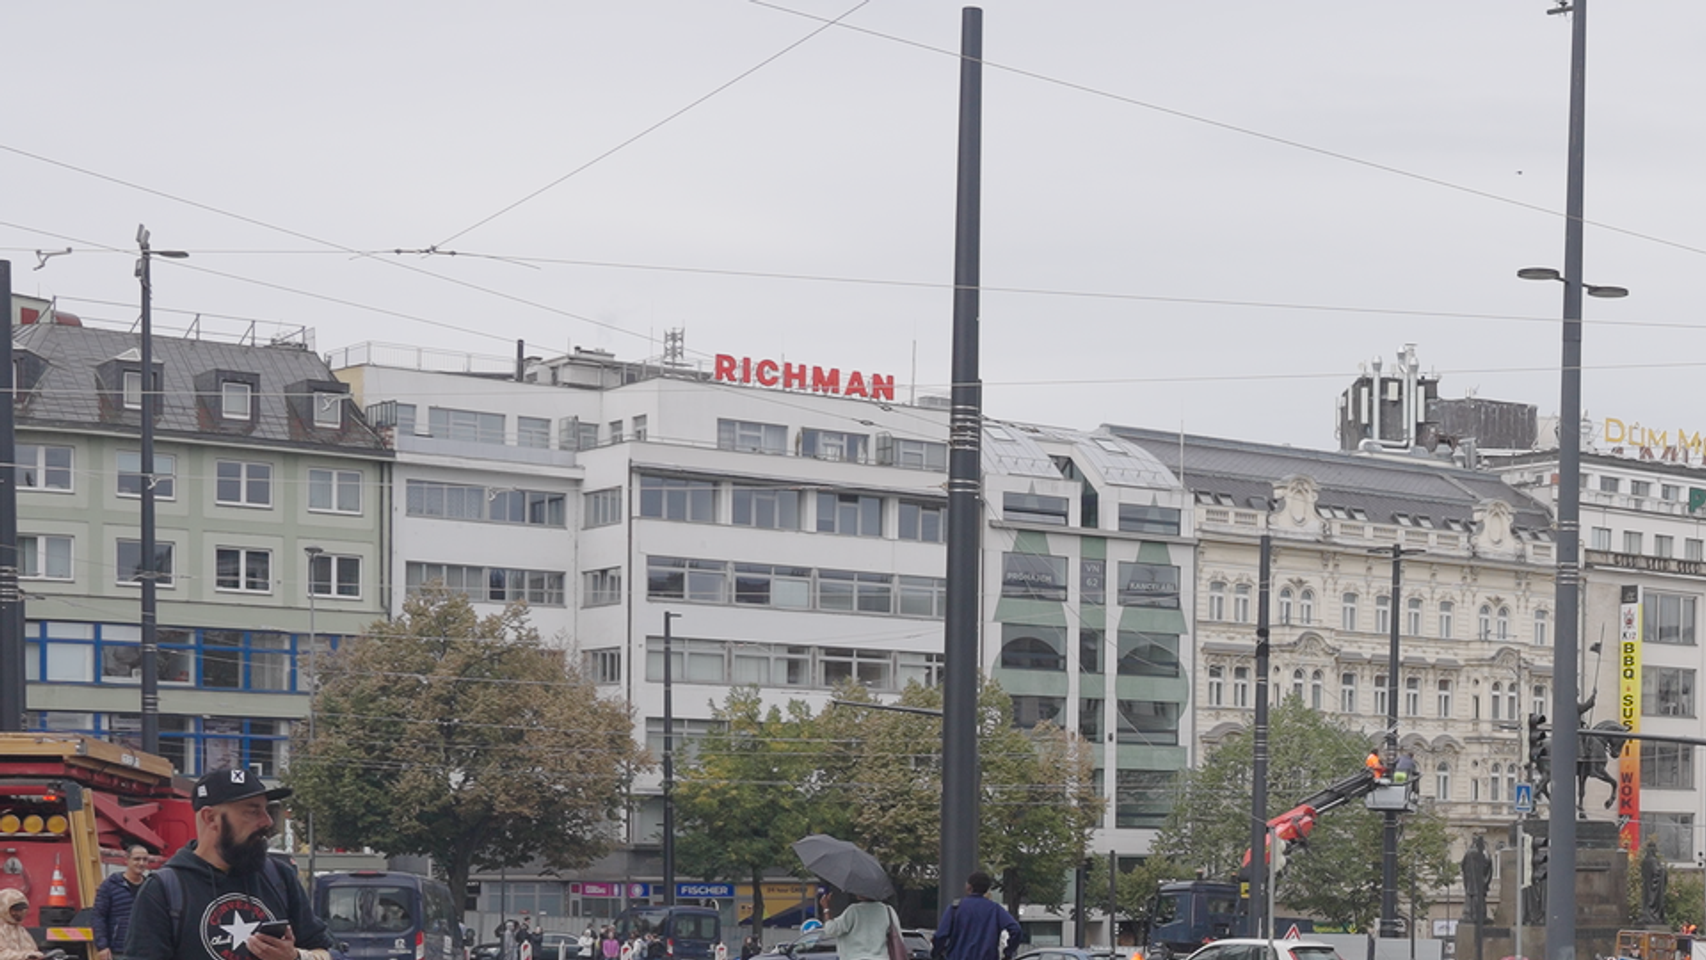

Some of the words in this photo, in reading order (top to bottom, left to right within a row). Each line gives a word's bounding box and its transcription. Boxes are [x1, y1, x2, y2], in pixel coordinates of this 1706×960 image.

[715, 354, 894, 400] RICHMAN
[1623, 642, 1635, 680] BBQ
[1622, 694, 1634, 756] SUSI
[1621, 772, 1633, 809] WOK
[681, 885, 728, 895] FISCHER
